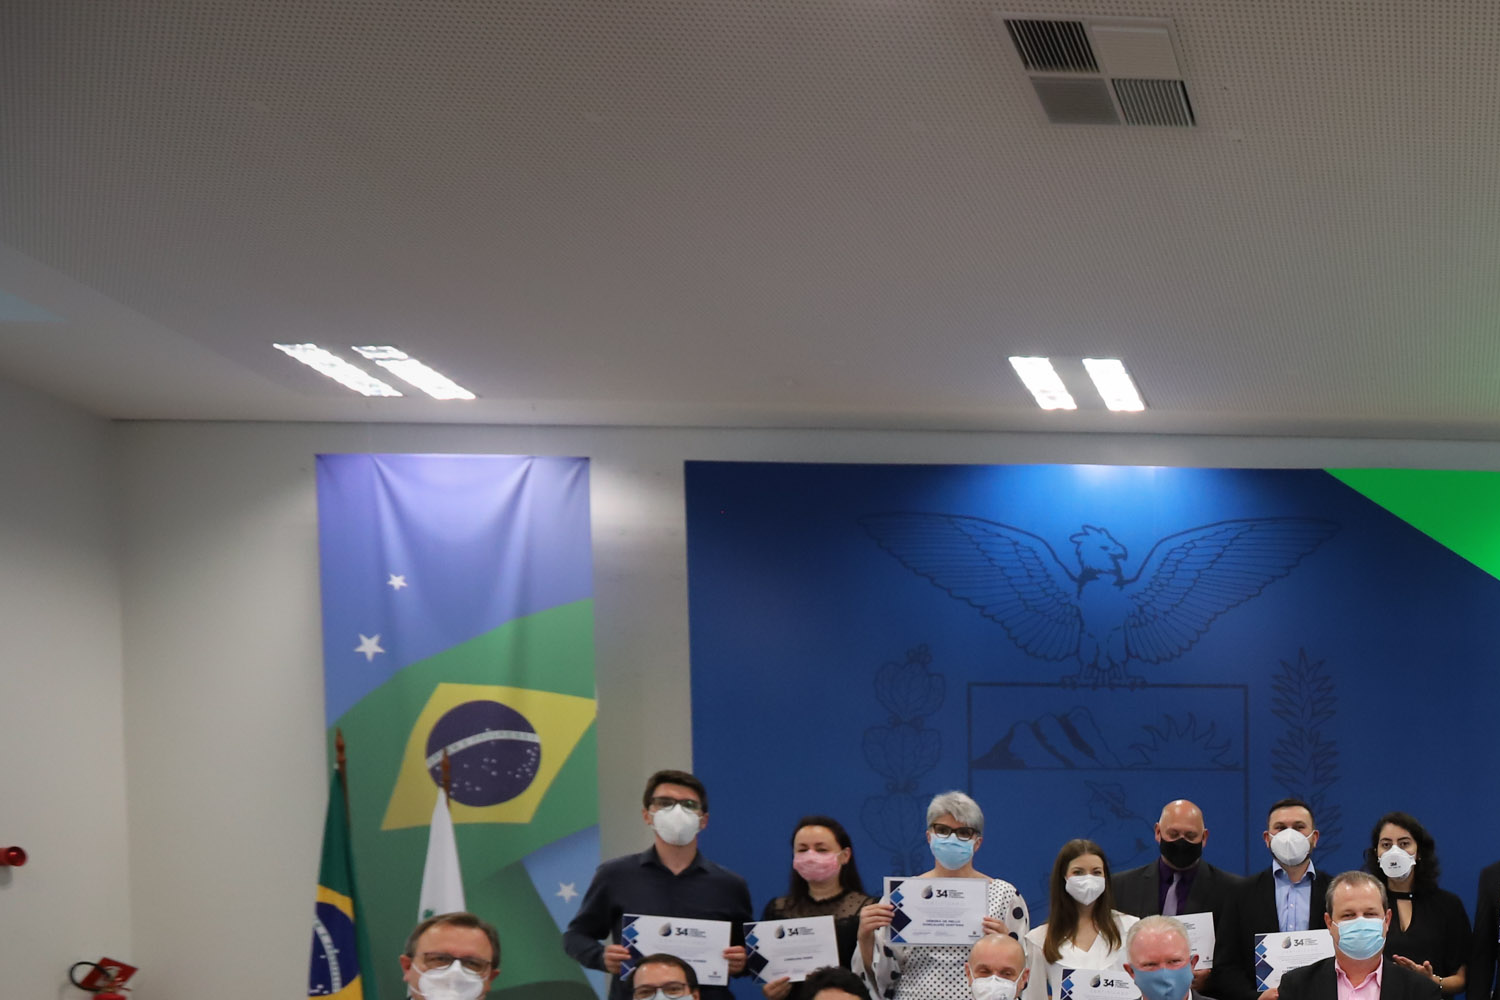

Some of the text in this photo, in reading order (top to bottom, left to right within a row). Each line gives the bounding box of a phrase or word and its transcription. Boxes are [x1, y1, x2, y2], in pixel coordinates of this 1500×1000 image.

[936, 889, 948, 898] 34
[675, 927, 688, 936] 34
[787, 928, 799, 936] 34
[1293, 939, 1304, 947] 34
[1103, 979, 1114, 987] 34
